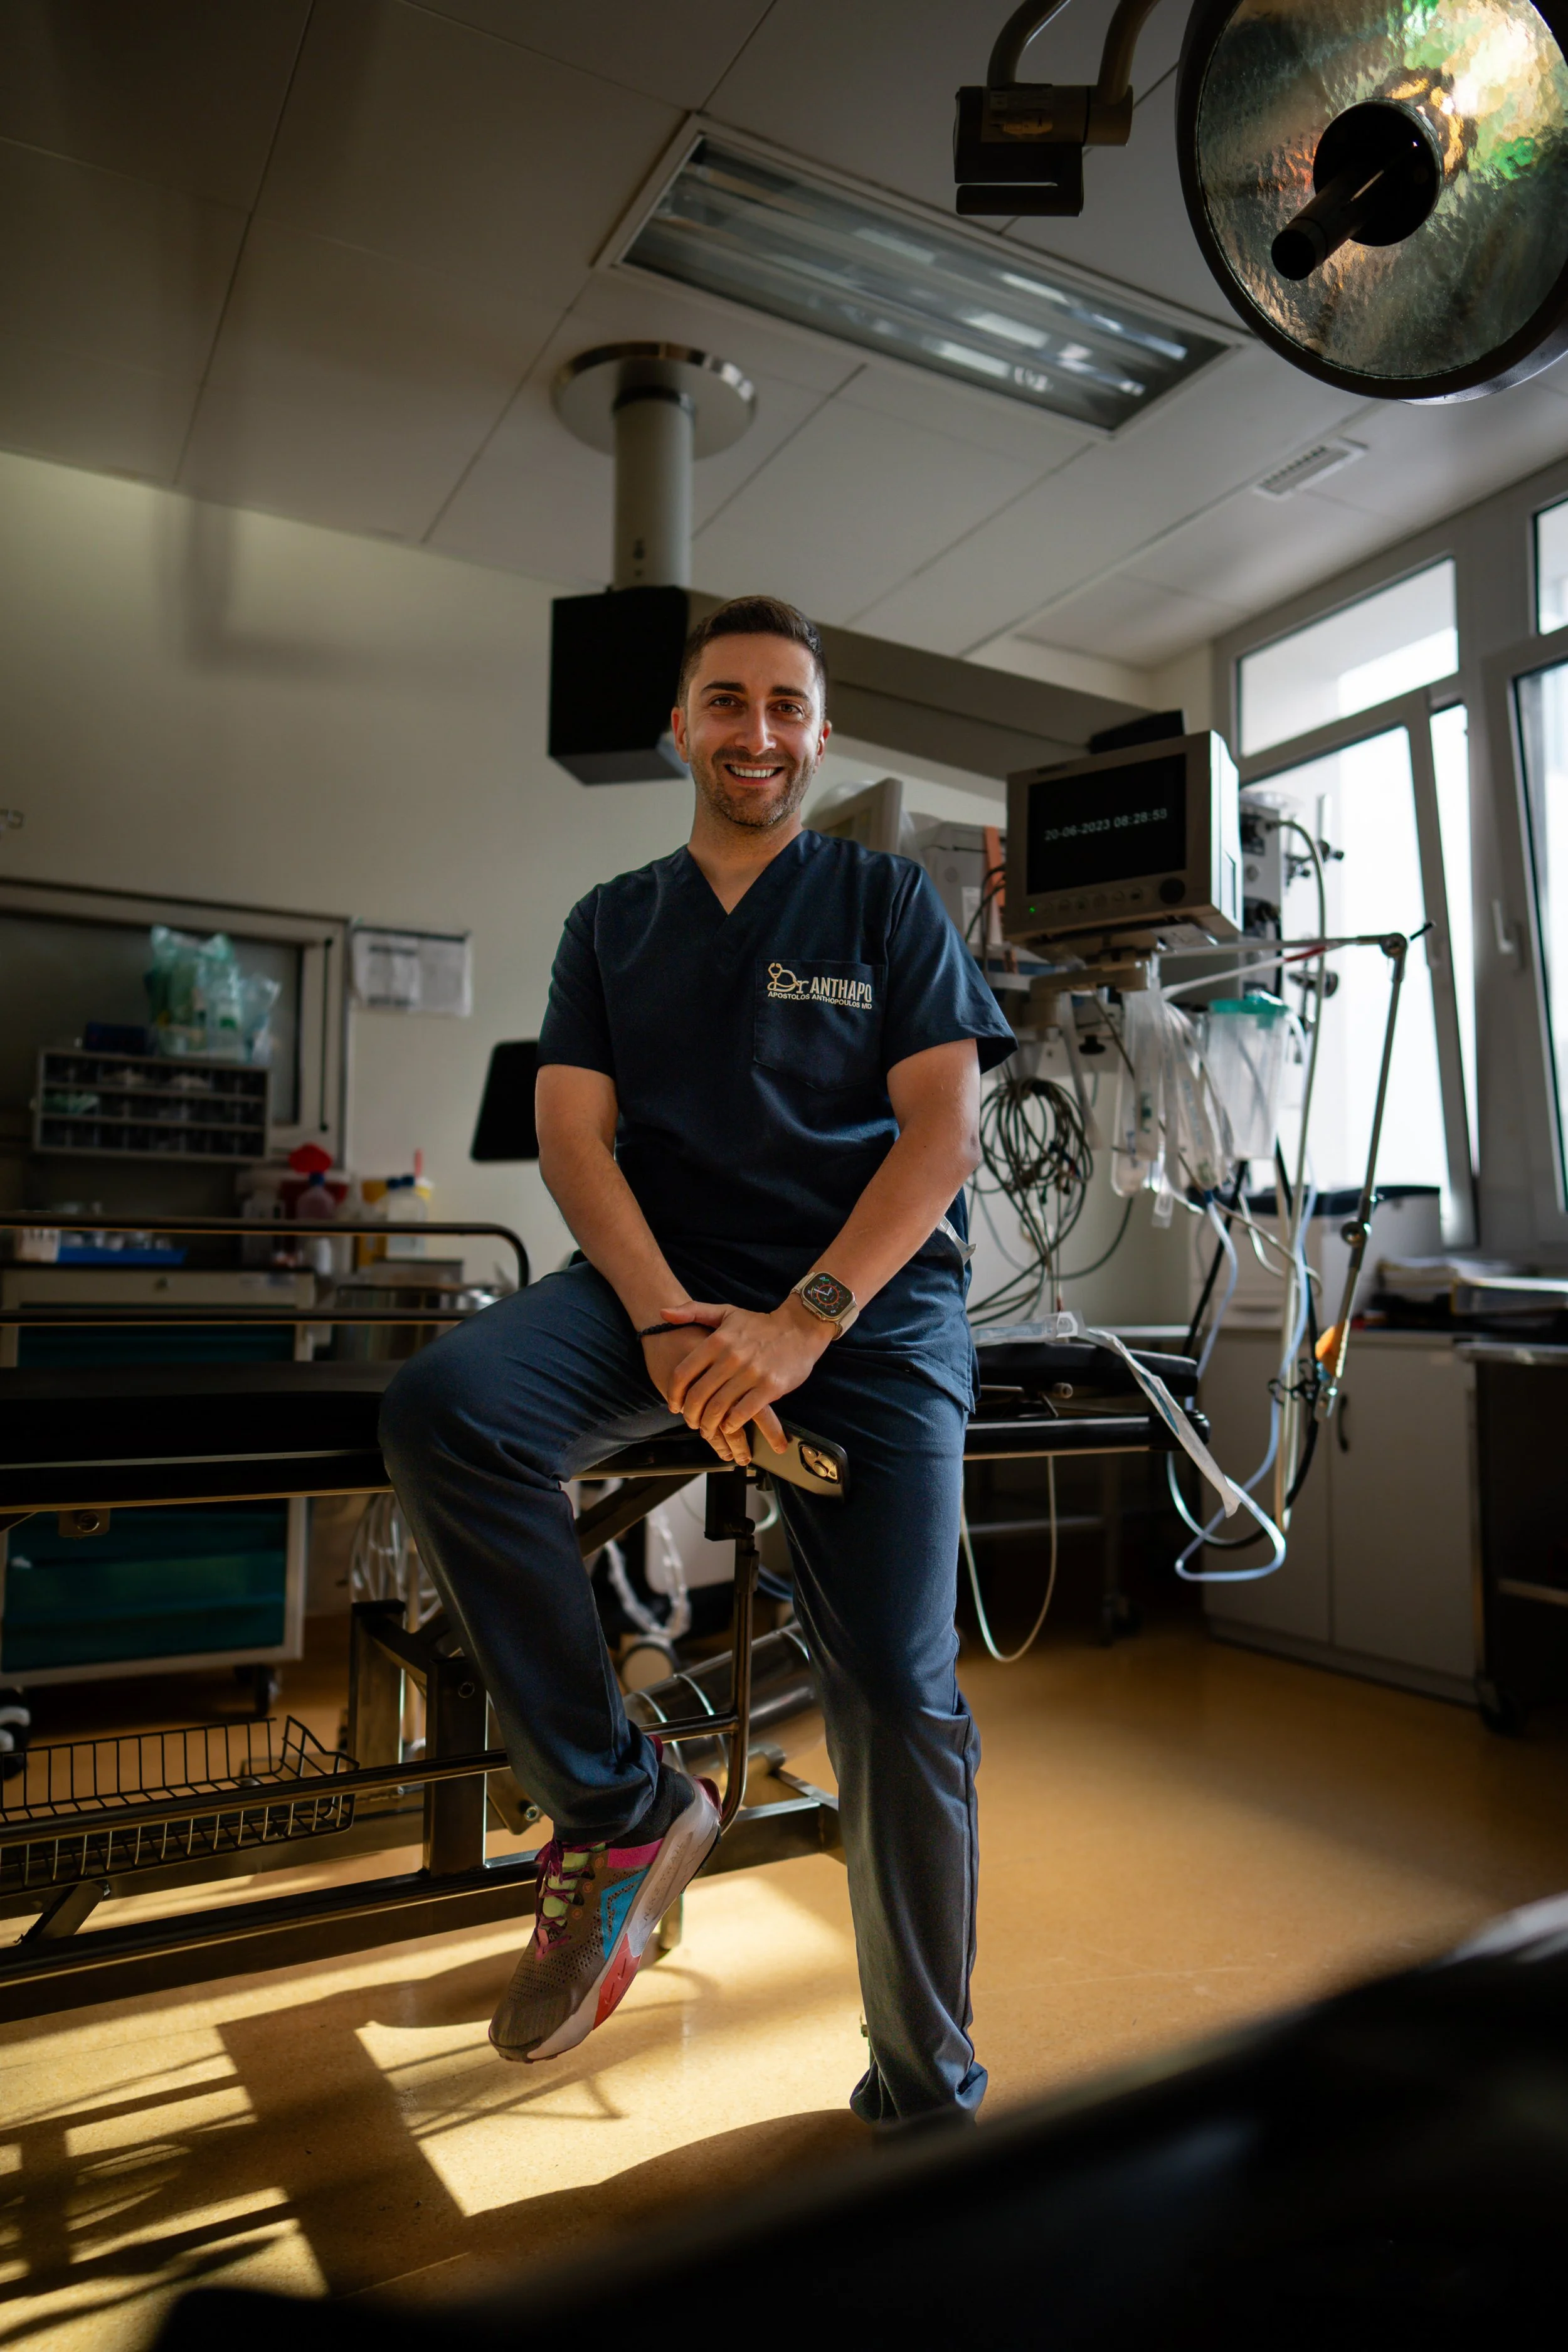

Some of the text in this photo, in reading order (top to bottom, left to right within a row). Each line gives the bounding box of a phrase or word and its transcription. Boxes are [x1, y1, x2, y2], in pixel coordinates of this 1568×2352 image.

[768, 991, 810, 1000] APOSTOLOS
[811, 994, 860, 1008] ANTHOPOULOS
[810, 977, 872, 1003] ANTHAPO
